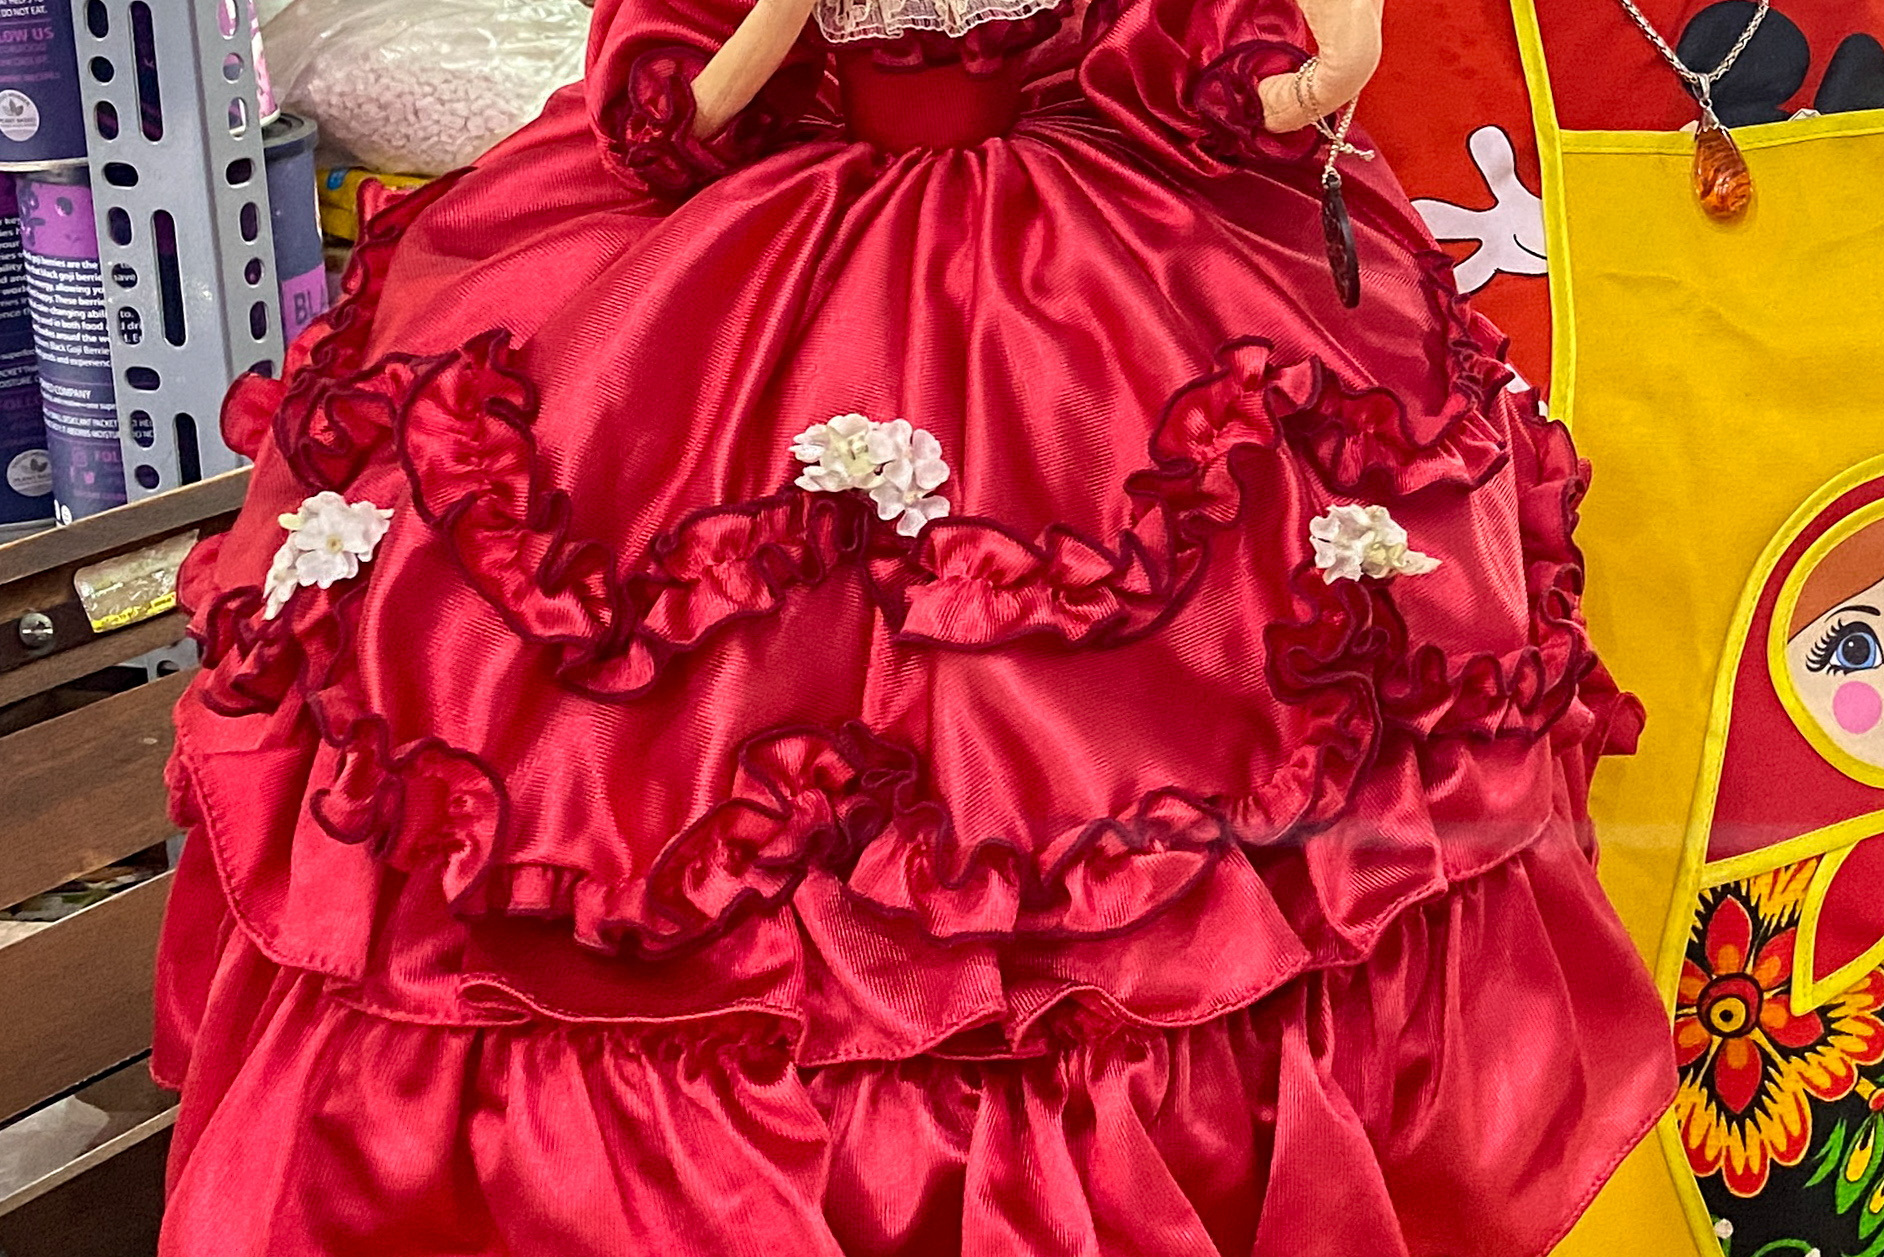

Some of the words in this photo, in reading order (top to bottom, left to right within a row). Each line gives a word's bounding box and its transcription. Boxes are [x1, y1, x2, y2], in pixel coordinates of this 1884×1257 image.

[32, 27, 55, 41] US
[67, 260, 80, 269] are
[82, 260, 98, 269] the
[82, 321, 103, 331] food
[82, 333, 97, 343] the
[83, 344, 110, 355] Berrie
[70, 356, 111, 368] experienc
